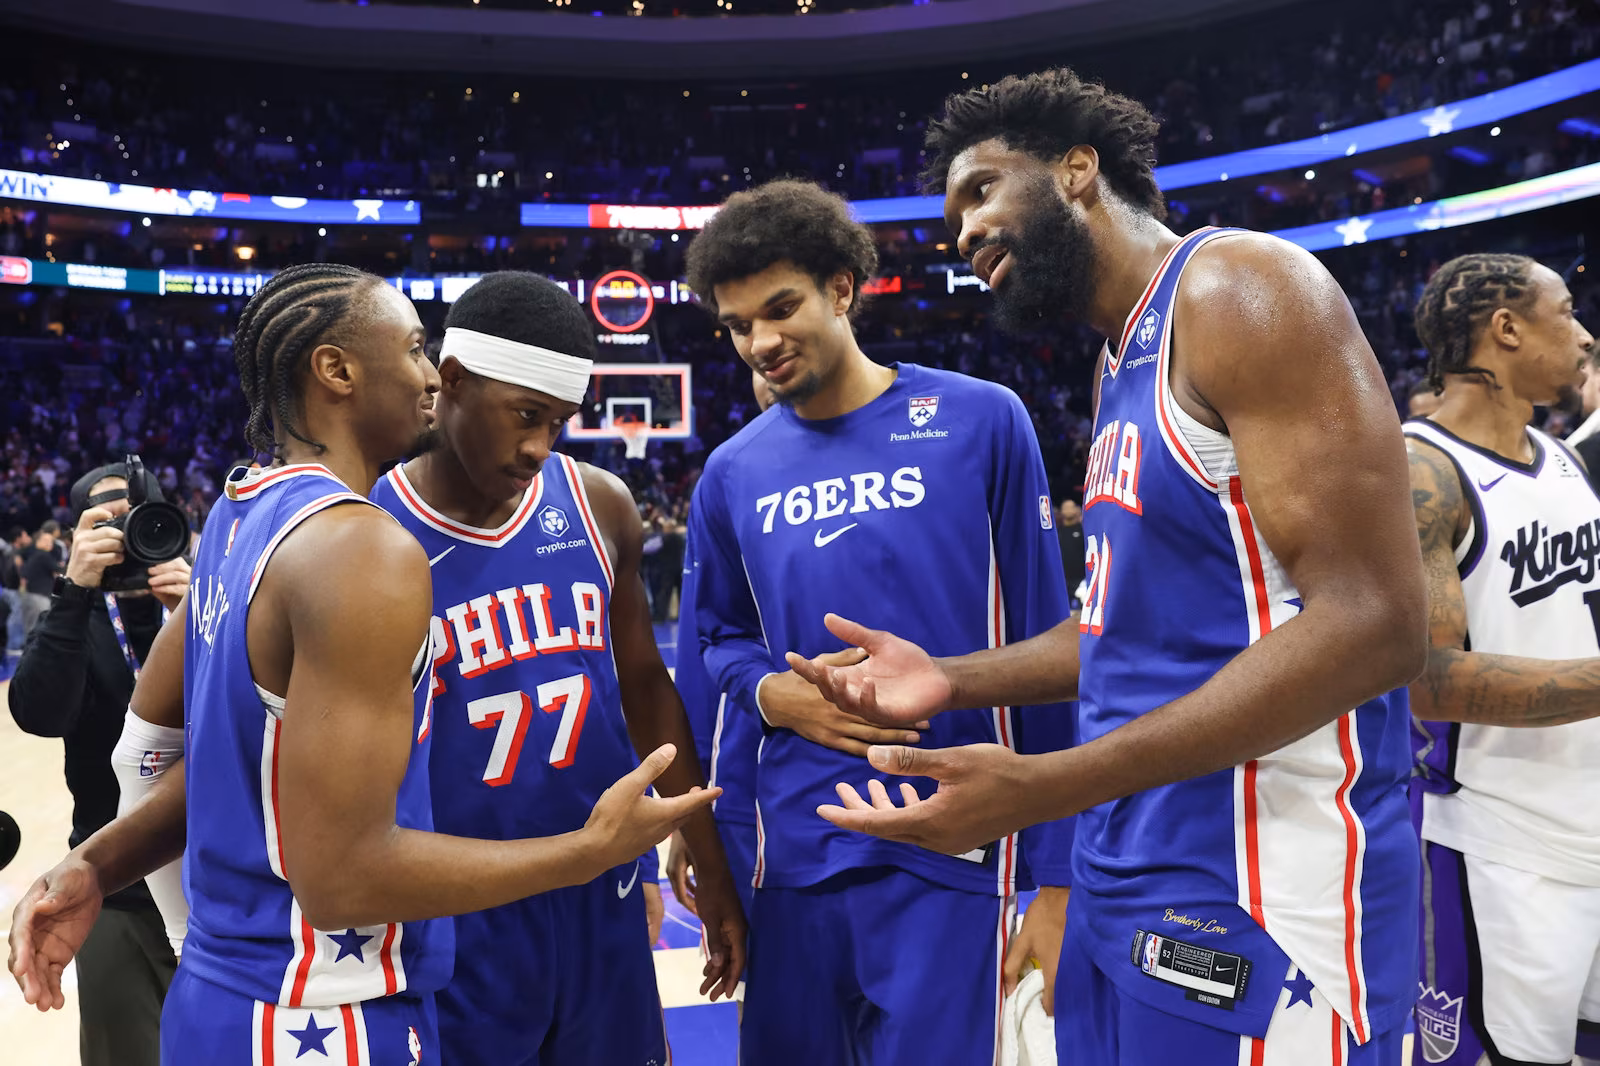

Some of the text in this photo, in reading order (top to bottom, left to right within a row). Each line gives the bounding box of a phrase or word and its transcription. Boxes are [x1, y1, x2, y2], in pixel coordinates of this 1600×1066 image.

[889, 428, 949, 442] Penn Medicine
[756, 466, 926, 534] 76ERS
[536, 537, 587, 556] crypto.com
[1500, 518, 1600, 596] King
[431, 581, 607, 694] PHILA
[467, 673, 592, 788] 77
[1163, 908, 1228, 935] Brotherly Love
[1162, 949, 1171, 959] 52
[1176, 945, 1212, 959] ENGINEERED
